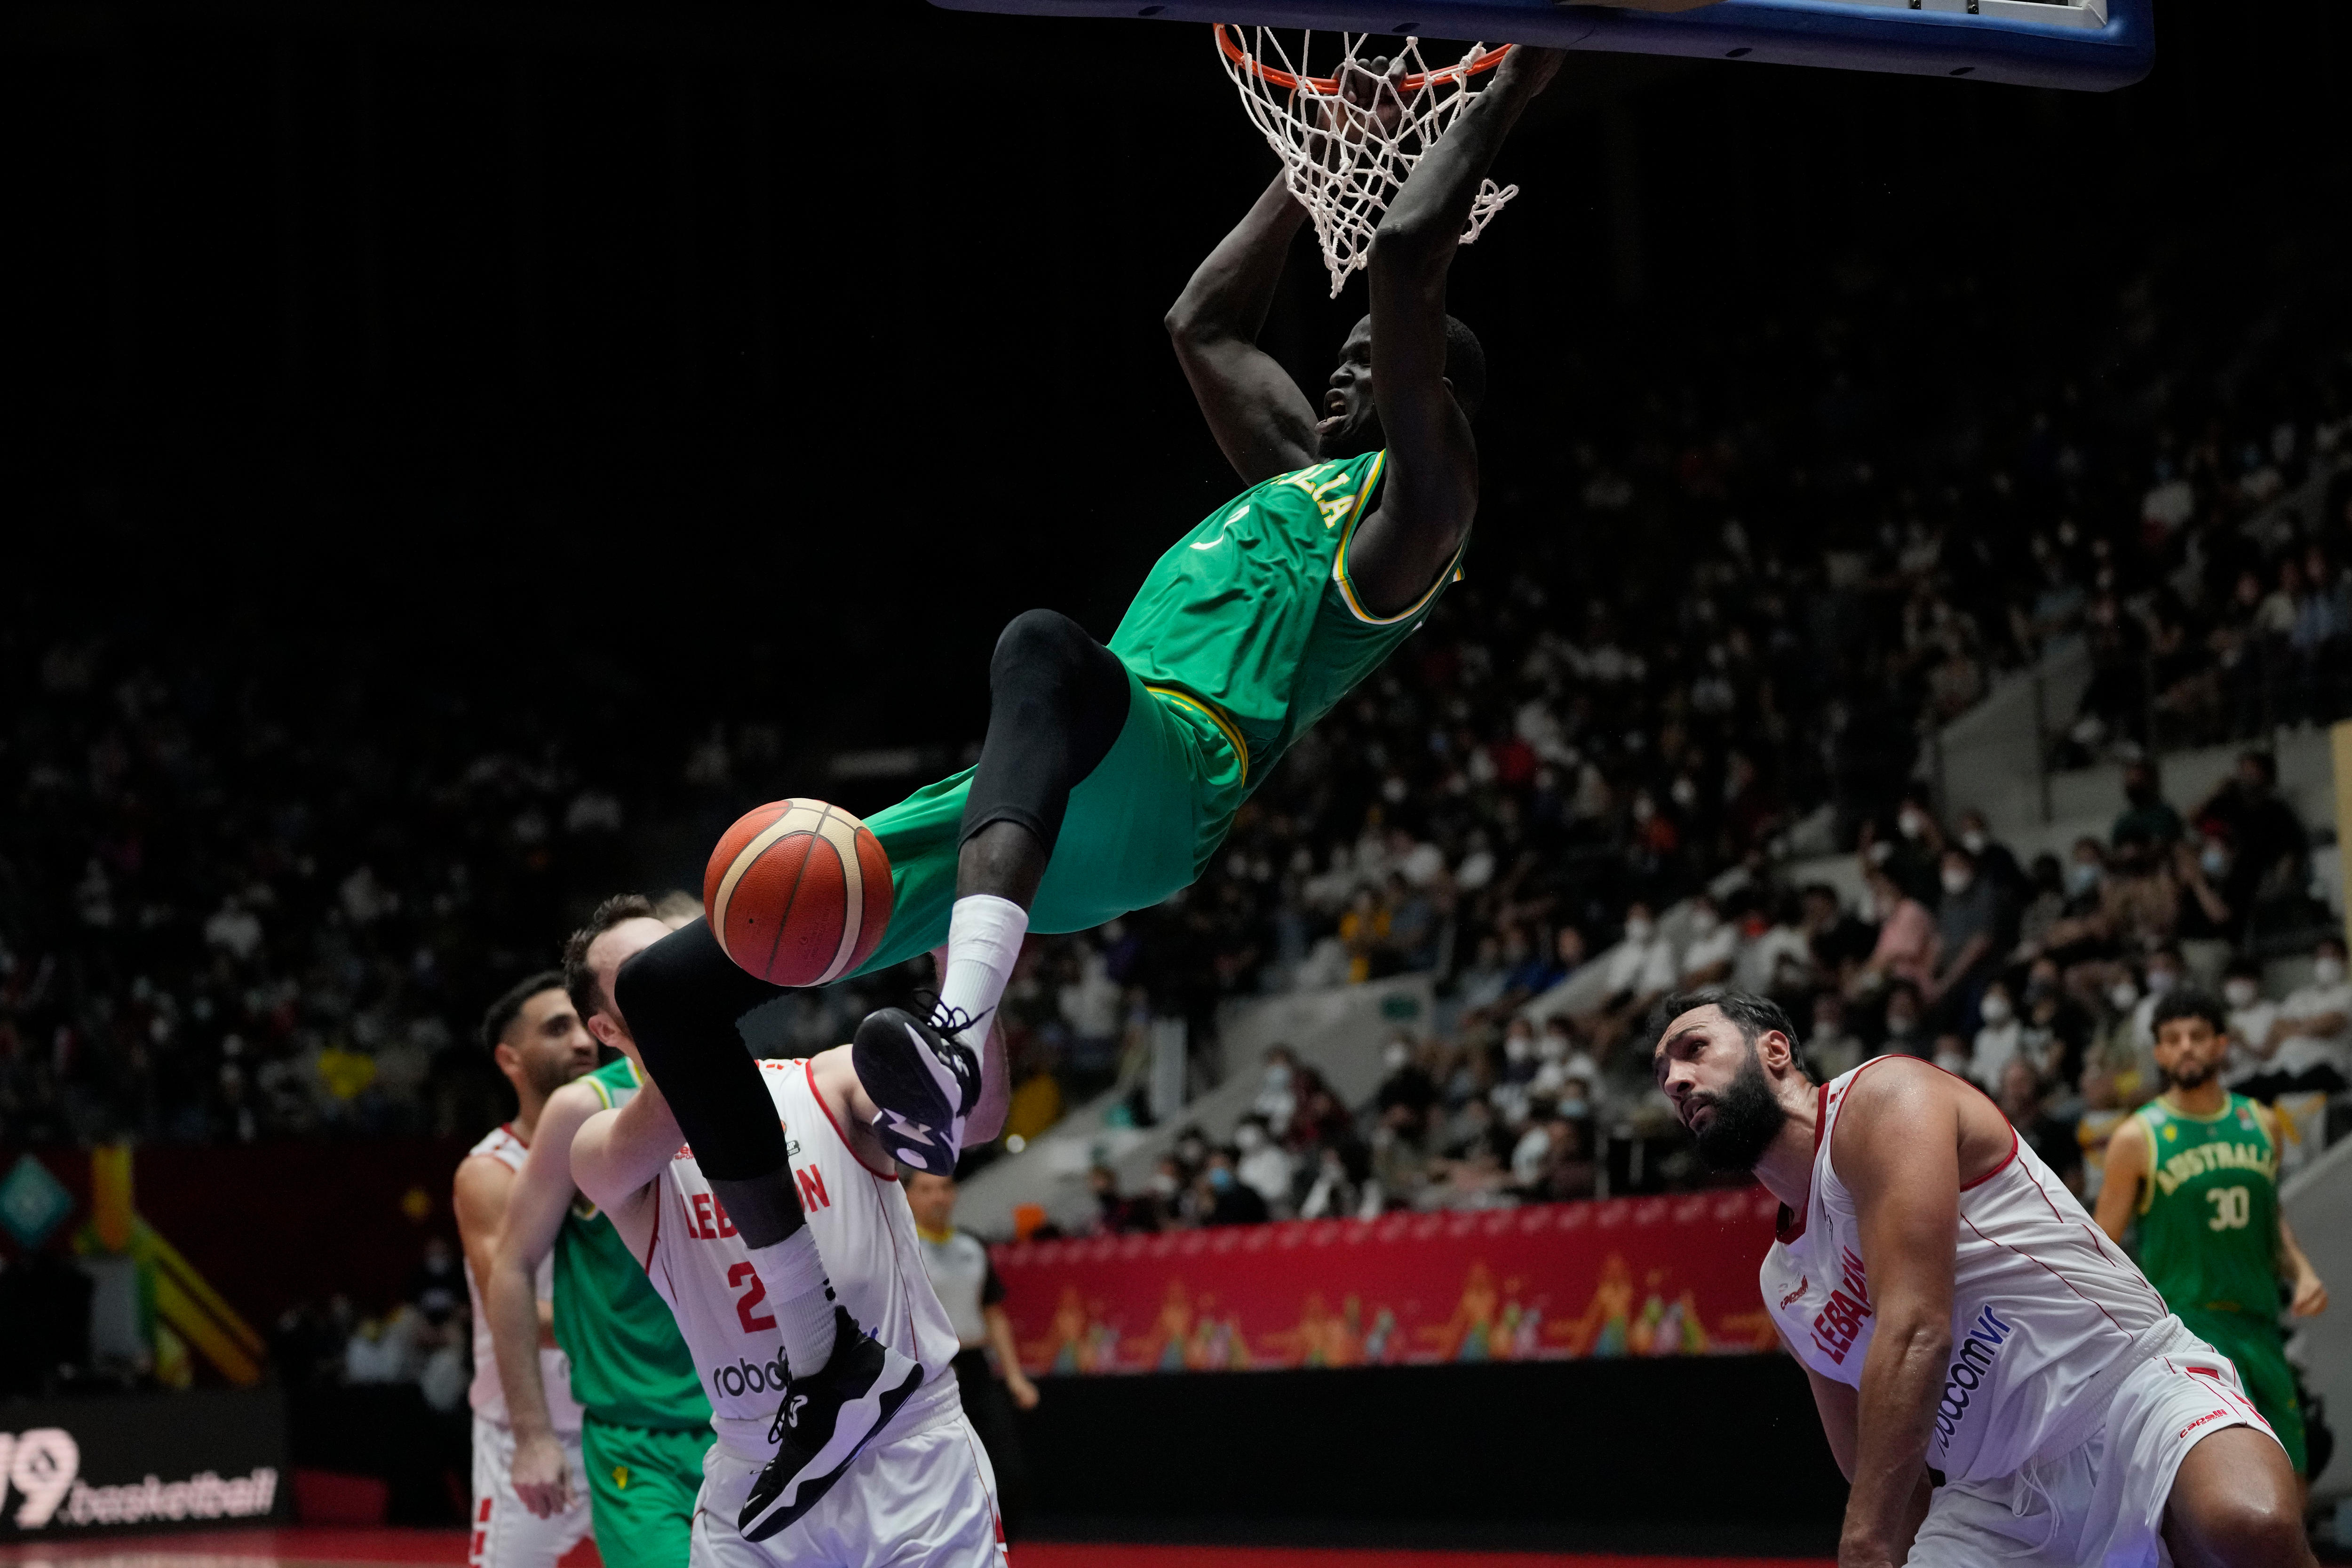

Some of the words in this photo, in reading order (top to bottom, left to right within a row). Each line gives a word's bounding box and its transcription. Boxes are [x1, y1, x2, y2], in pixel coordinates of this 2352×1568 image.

[2206, 1186, 2249, 1232] 30
[714, 1357, 786, 1398] robo
[2180, 1409, 2228, 1438] capelli
